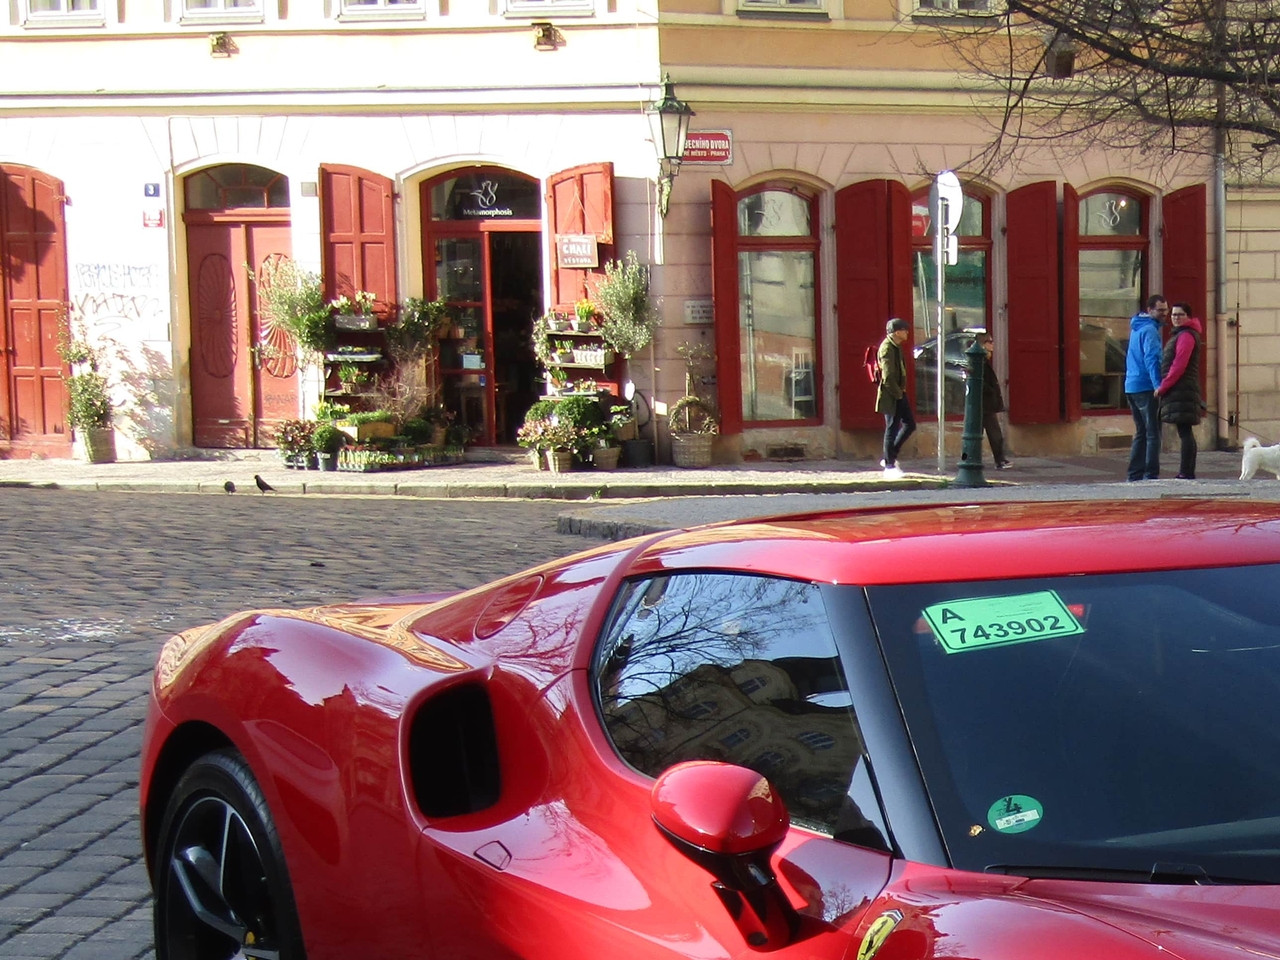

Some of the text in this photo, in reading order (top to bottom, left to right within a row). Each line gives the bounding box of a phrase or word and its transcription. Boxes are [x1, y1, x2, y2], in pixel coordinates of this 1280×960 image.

[710, 139, 730, 150] DVORA
[463, 207, 513, 217] Metamorphosis
[941, 608, 966, 625] A
[950, 615, 1066, 645] 743902
